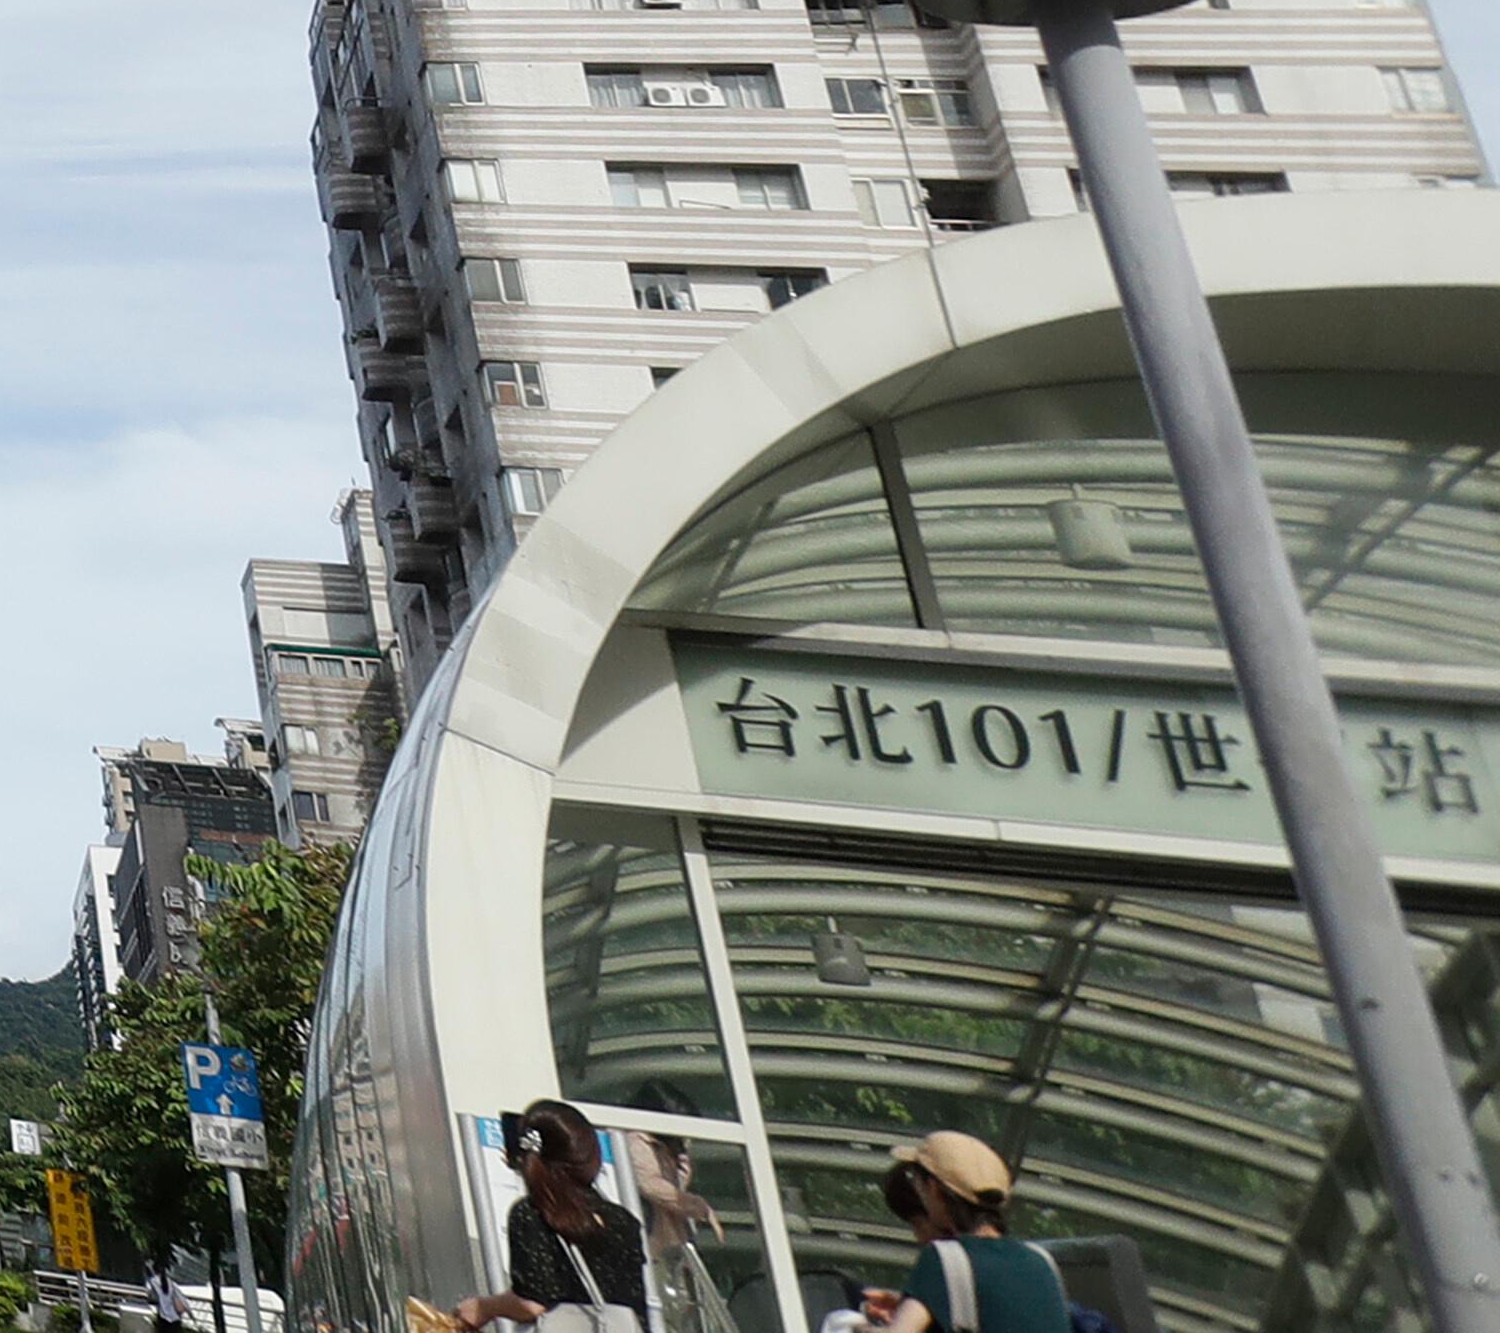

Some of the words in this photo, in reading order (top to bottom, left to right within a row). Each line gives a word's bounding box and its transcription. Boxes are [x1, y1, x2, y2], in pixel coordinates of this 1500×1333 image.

[715, 676, 1482, 820] 台北101/世站
[184, 1044, 221, 1090] P
